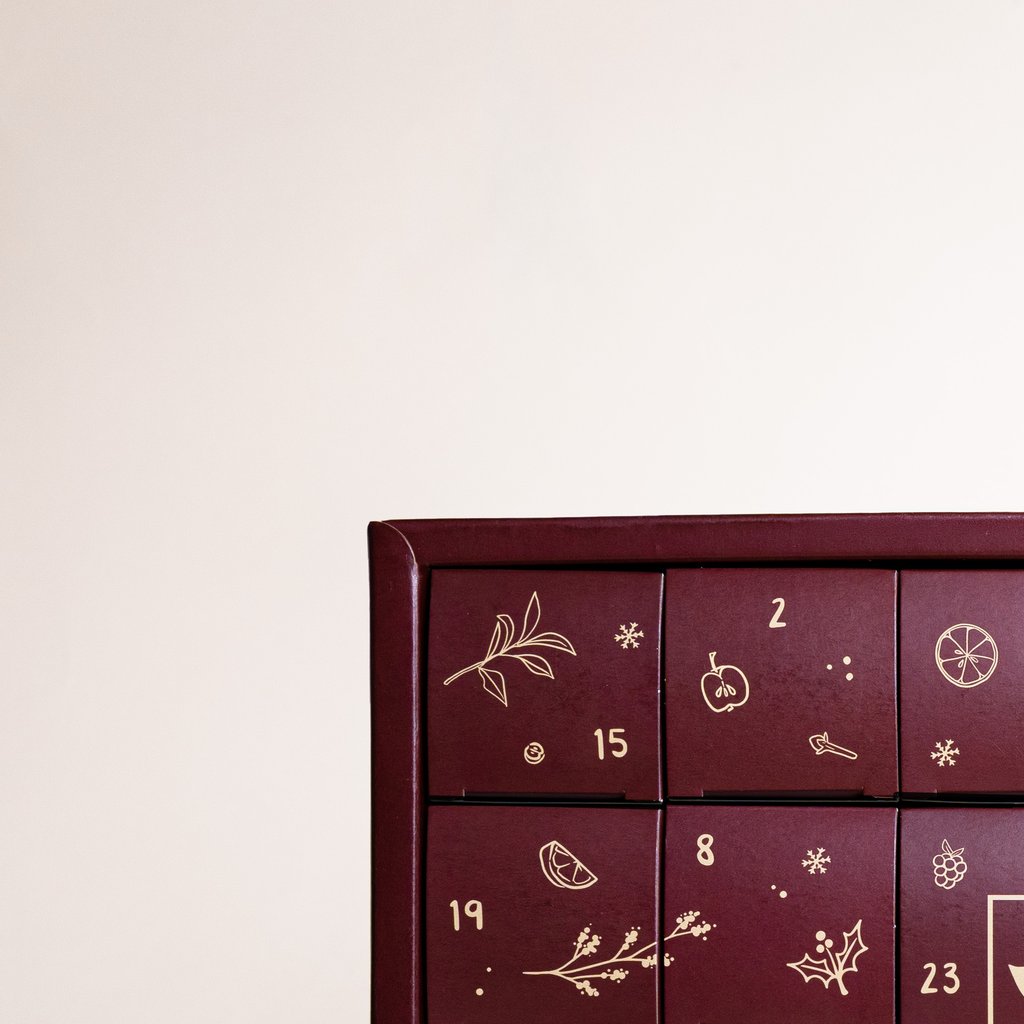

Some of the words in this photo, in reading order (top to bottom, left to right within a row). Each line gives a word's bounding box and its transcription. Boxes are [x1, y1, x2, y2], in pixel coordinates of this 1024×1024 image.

[768, 597, 787, 629] 2
[594, 728, 628, 760] 15
[696, 833, 715, 866] 8
[449, 899, 483, 931] 19
[920, 962, 960, 994] 23
